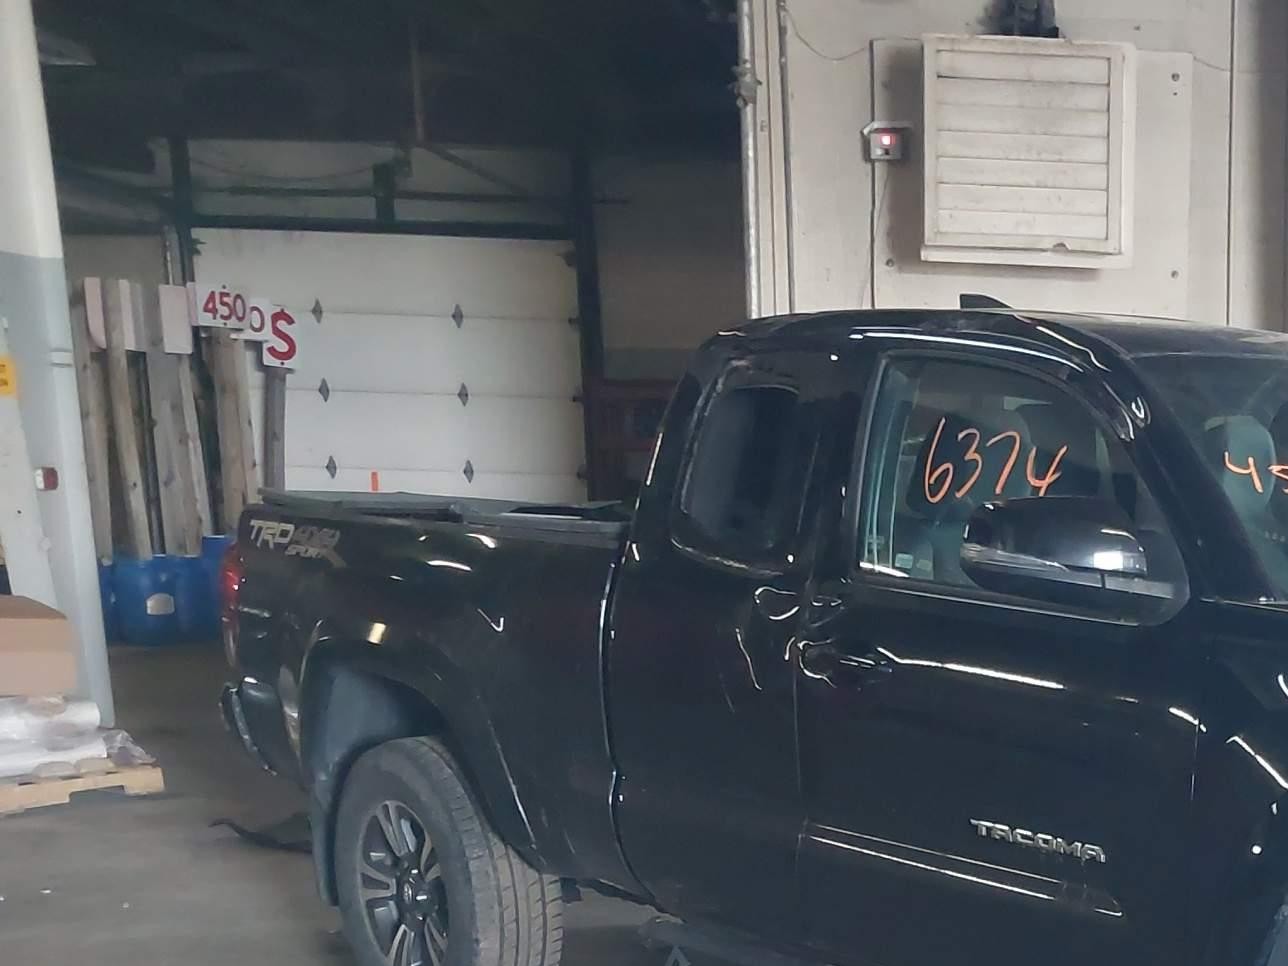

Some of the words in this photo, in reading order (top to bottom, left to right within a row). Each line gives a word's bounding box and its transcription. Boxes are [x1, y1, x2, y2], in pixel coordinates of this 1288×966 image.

[203, 290, 246, 322] 450
[925, 416, 1068, 504] 6374
[249, 518, 295, 550] TRD
[969, 818, 1106, 864] TACOMA
